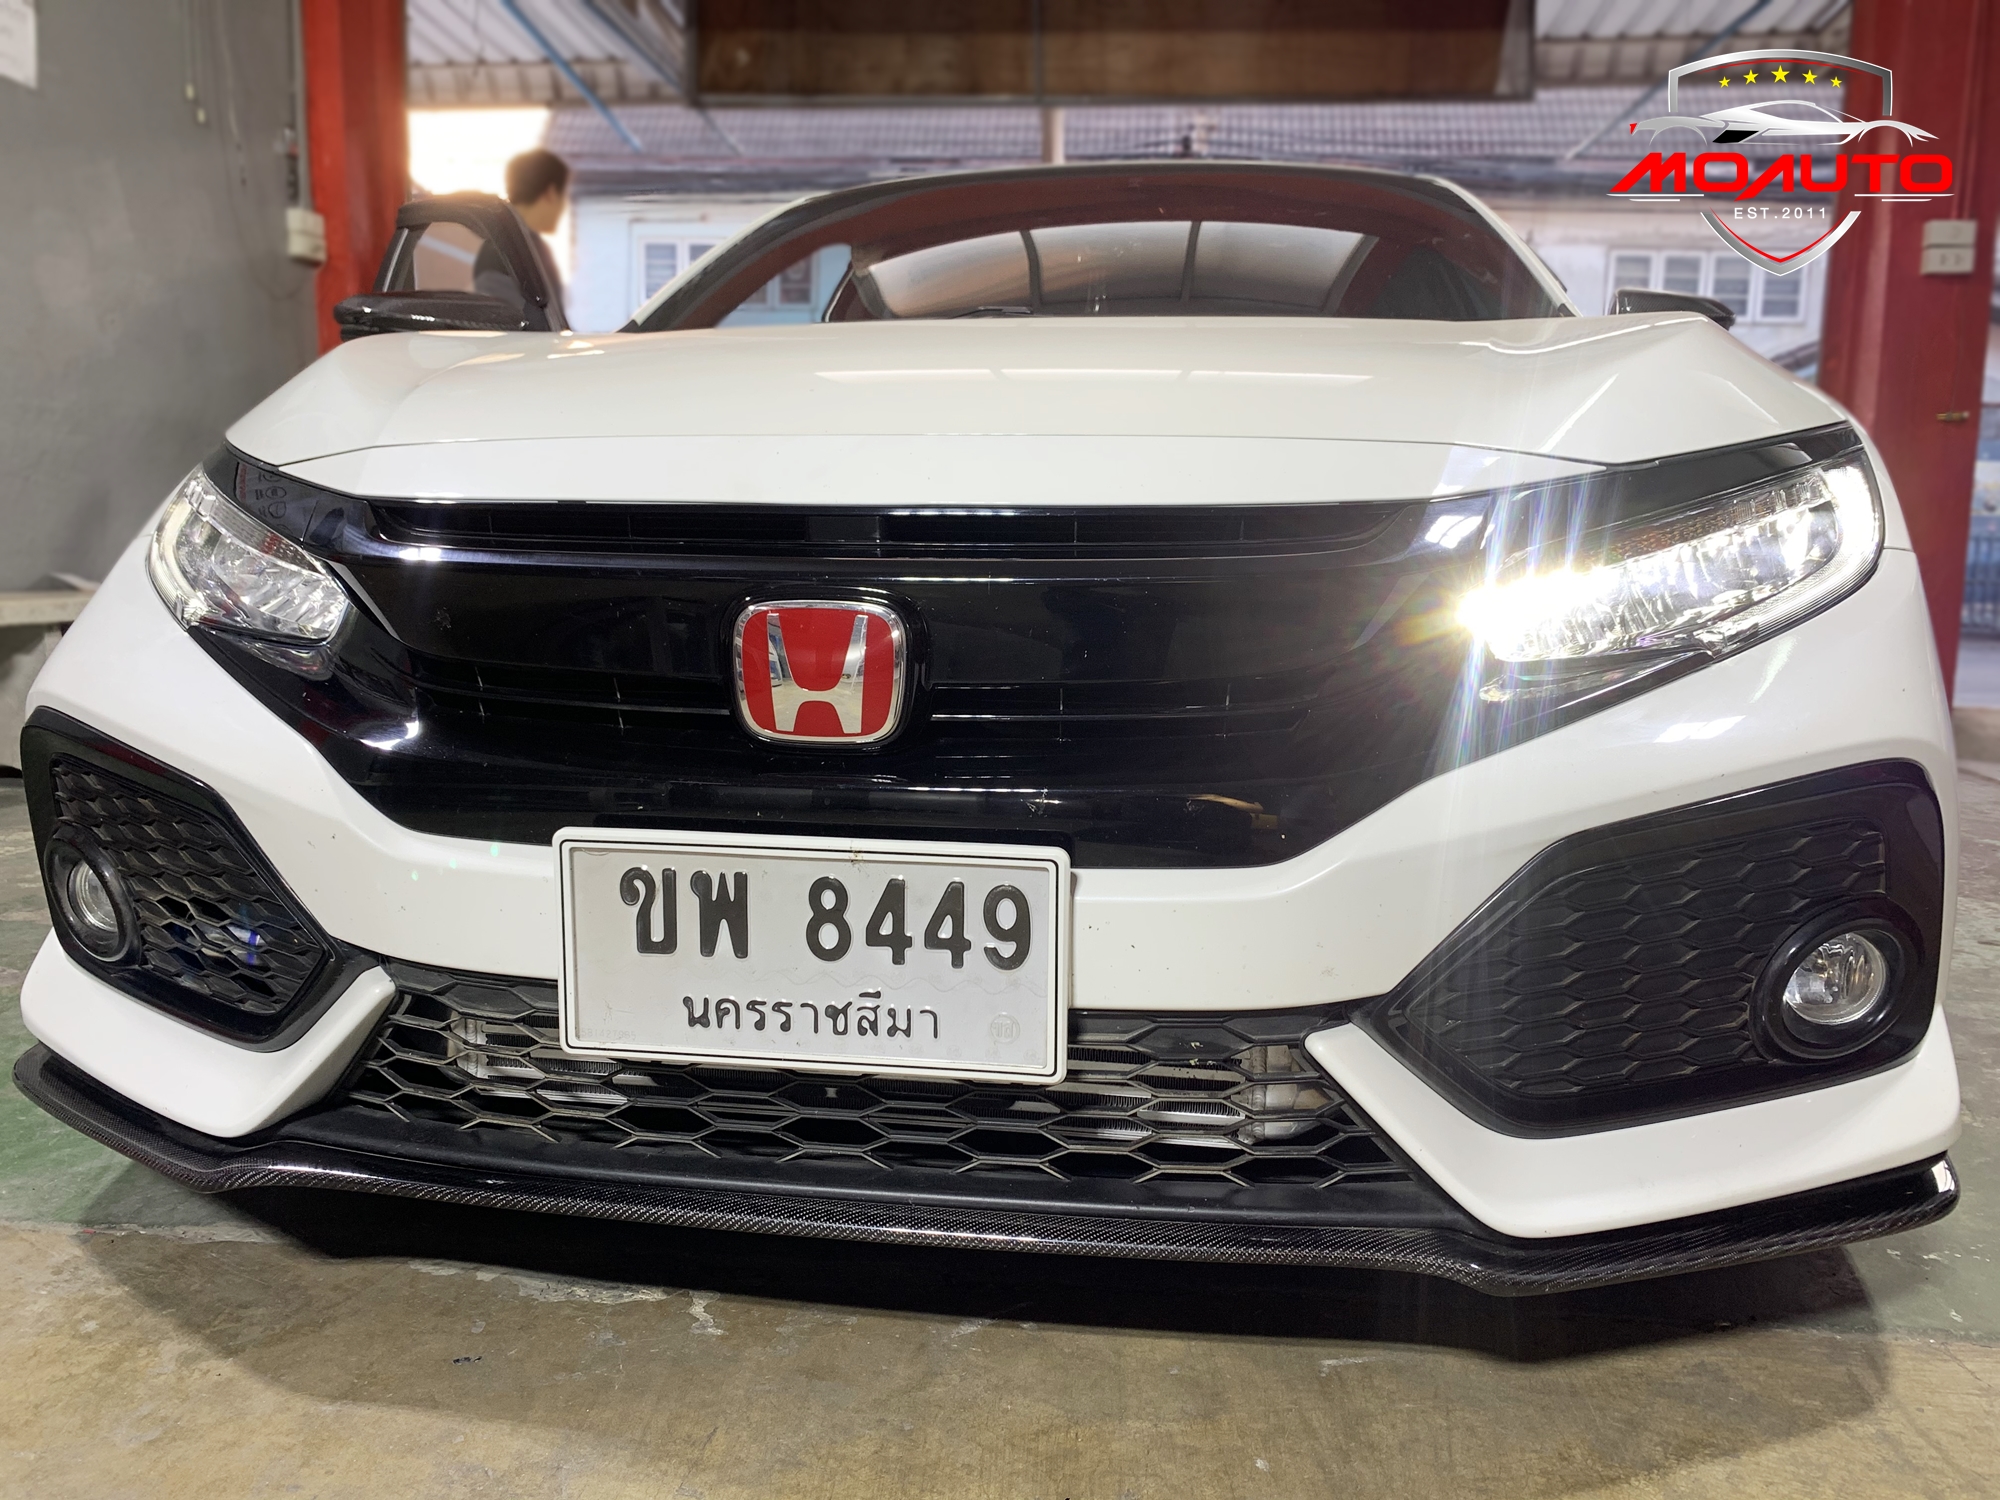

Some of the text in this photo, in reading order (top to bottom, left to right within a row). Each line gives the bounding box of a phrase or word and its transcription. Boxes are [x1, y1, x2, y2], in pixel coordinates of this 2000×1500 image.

[619, 866, 1031, 971] ขพ 8449
[683, 990, 939, 1037] นครราชสีมา
